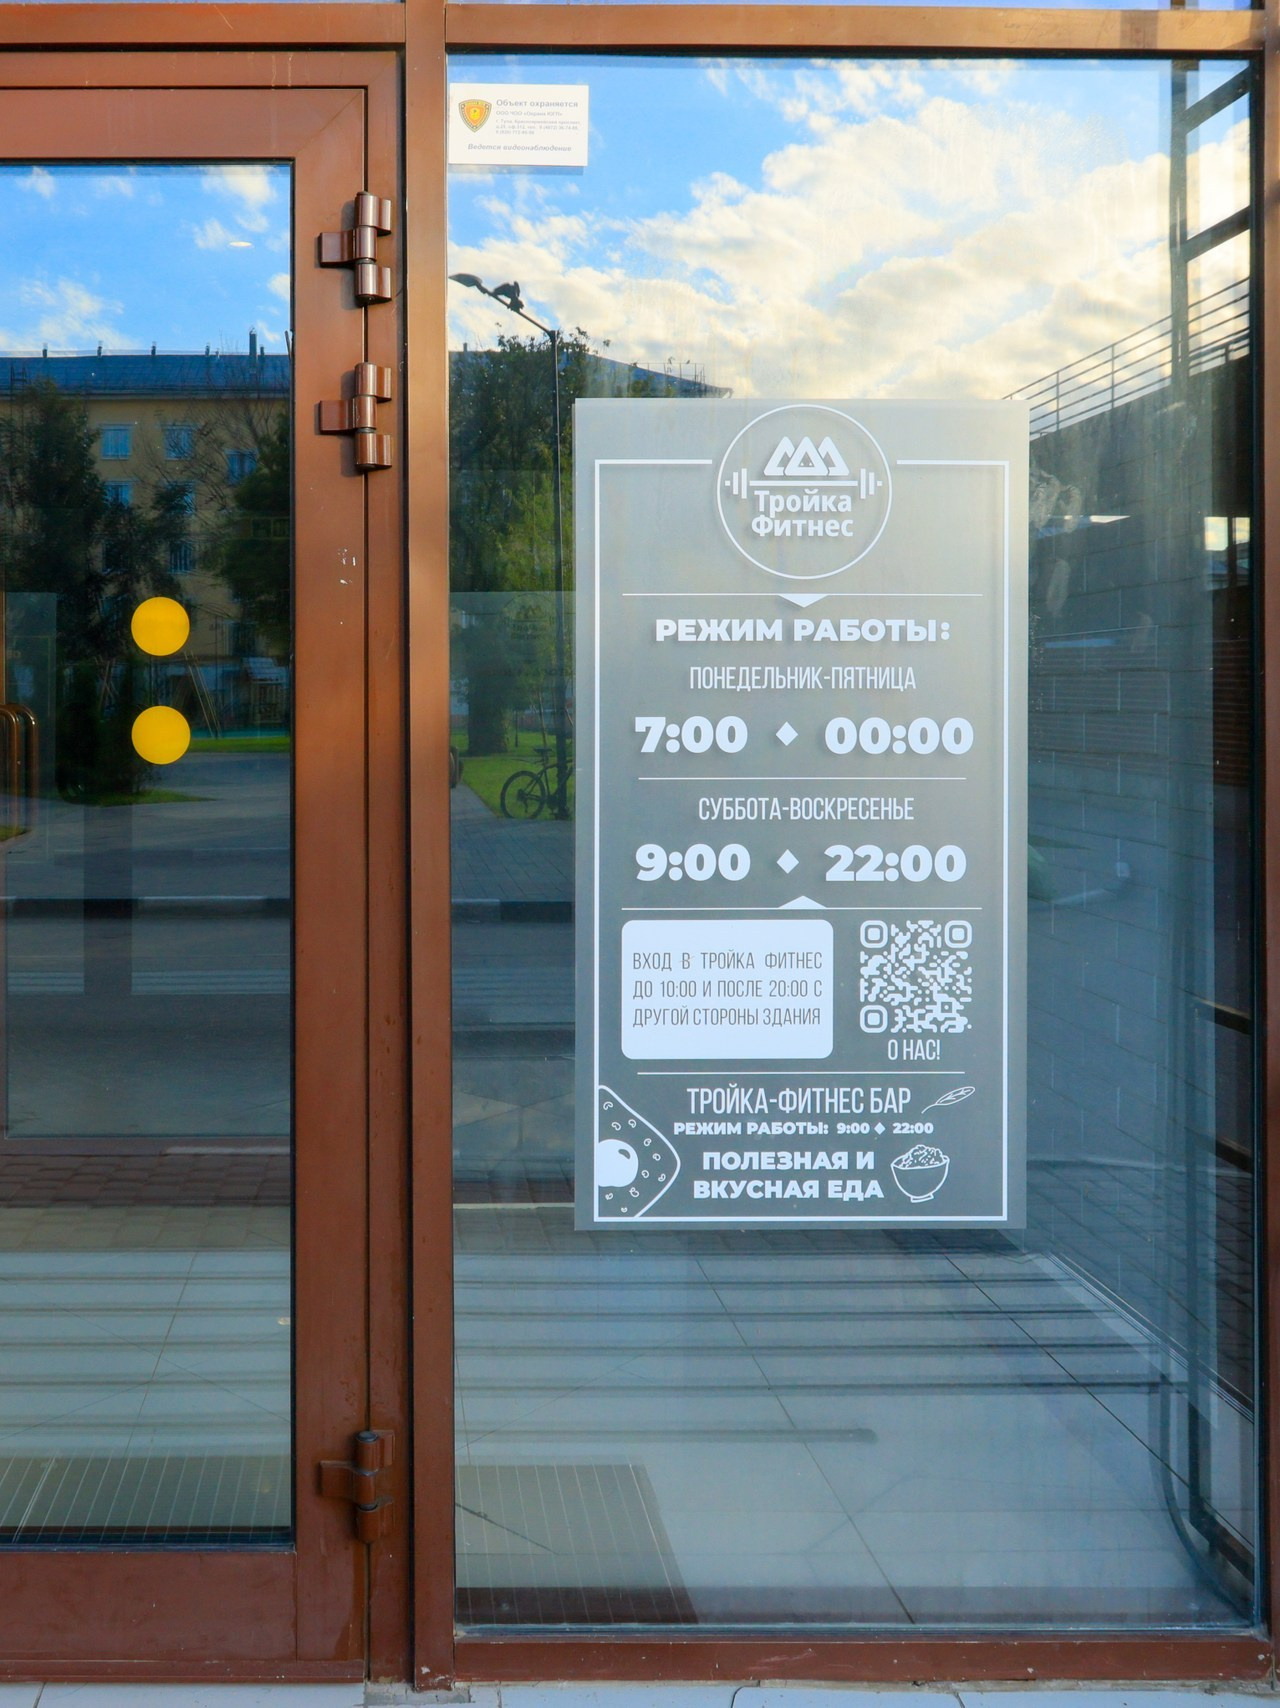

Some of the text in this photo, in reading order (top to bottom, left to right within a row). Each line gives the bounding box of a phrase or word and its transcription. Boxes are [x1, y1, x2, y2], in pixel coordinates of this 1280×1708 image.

[496, 99, 579, 109] Объект охраняется
[503, 144, 572, 152] видеонаблюдение
[753, 489, 853, 518] Тройка
[751, 515, 854, 537] Фитнес
[656, 619, 950, 641] РЕЖИМ РАБОТЫ:
[690, 666, 917, 692] ПОНЕДЕЛЬНИК-ПЯТНИЦА
[635, 716, 973, 754] 7:00 00:00
[699, 798, 914, 820] СУББОТА-ВОСКРЕСЕНЬЕ
[636, 844, 966, 882] 9:00 22:00
[634, 950, 822, 971] ВХОД В ТРОЙКА ФИТНЕС
[633, 980, 822, 999] ДО 10:00 И ПОСЛЕ 20:00 С
[633, 1006, 820, 1027] ДРУГОЙ СТОРОНЫ ЗДАНИЯ
[888, 1039, 940, 1060] О НАС!
[687, 1083, 910, 1113] ТРОЙКА-ФИТНЕС БАР
[674, 1122, 934, 1135] РЕЖИМ РАБОТЫ: 9:00 22:00
[703, 1151, 874, 1170] ПОЛЕЗНАЯ И
[694, 1180, 884, 1201] ВКУСНАЯ ЕДА
